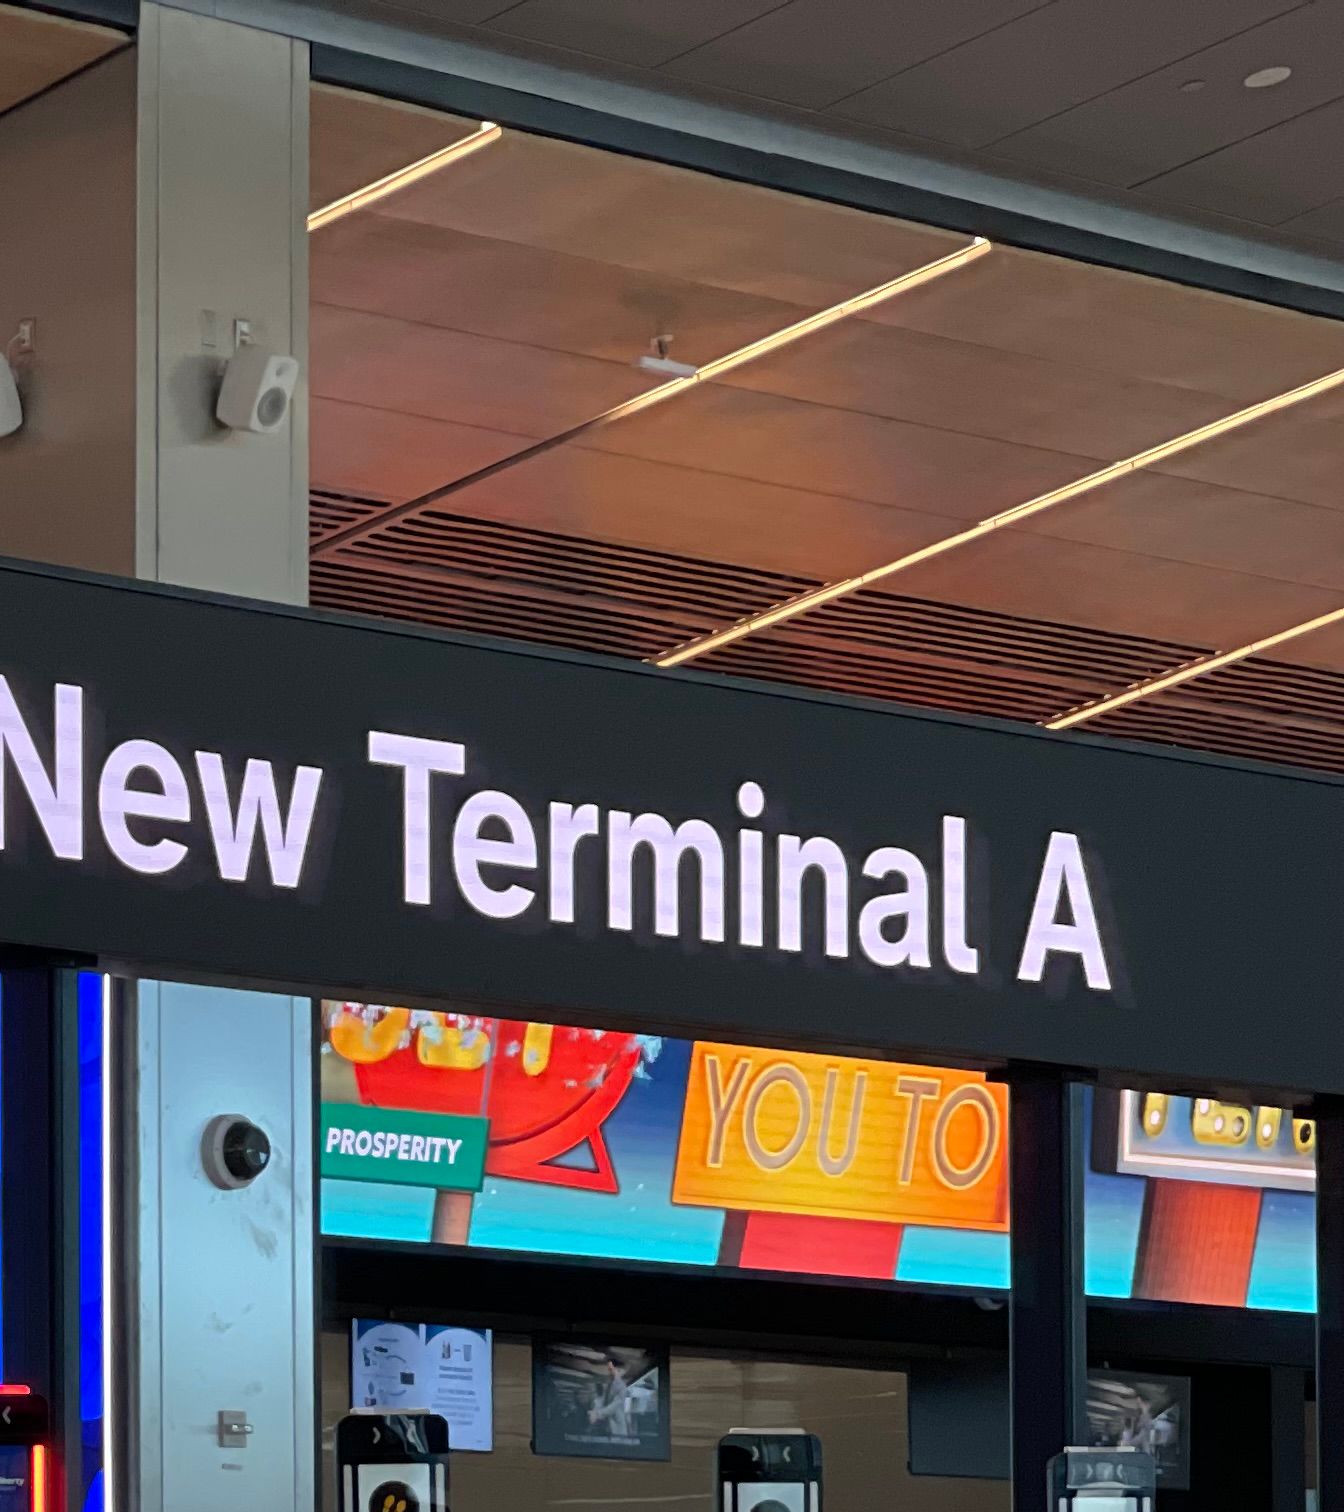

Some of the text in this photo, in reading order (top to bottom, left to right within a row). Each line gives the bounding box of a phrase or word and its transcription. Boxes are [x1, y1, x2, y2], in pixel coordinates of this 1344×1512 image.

[369, 731, 978, 973] Terminal
[1017, 832, 1111, 990] A
[326, 1127, 463, 1165] PROSPERITY
[704, 1054, 868, 1178] YOU
[897, 1075, 1000, 1191] TO
